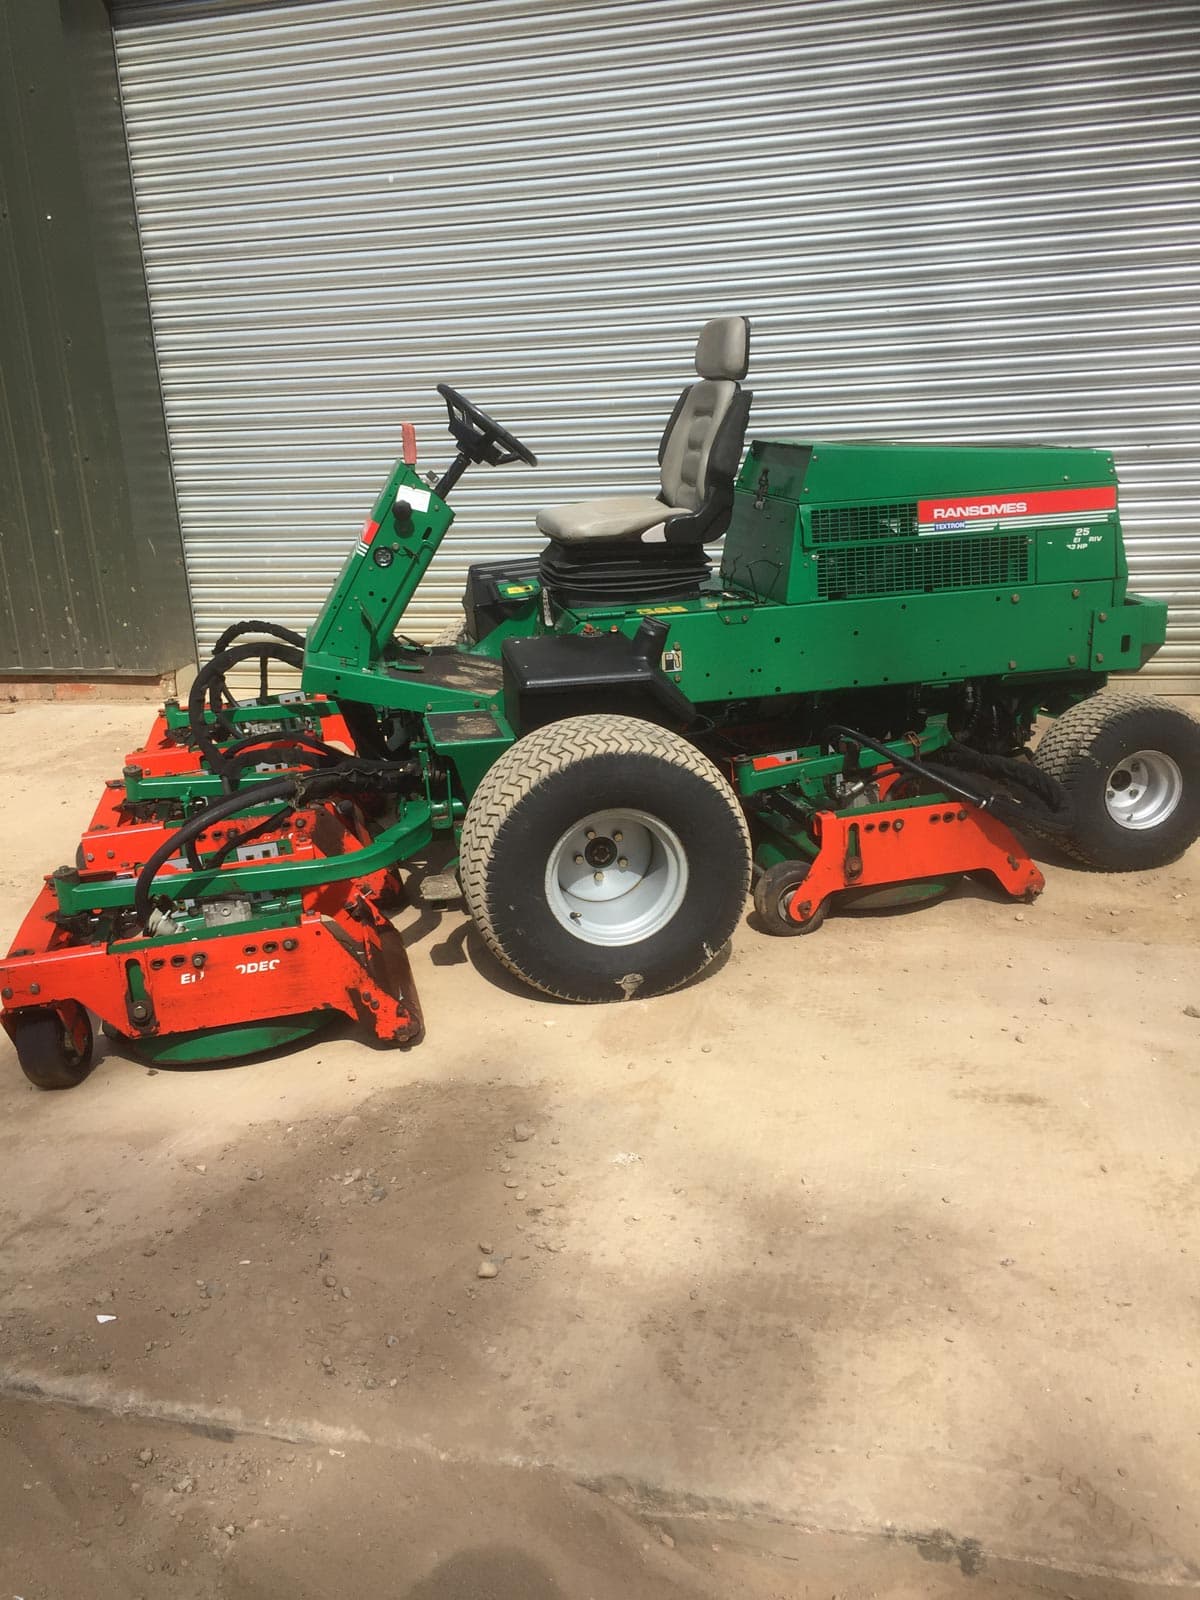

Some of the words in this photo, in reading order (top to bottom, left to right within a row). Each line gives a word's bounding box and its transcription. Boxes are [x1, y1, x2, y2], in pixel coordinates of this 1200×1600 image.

[933, 502, 1027, 519] RANSOMES
[935, 521, 965, 530] TEXTRON
[1075, 527, 1090, 536] 25
